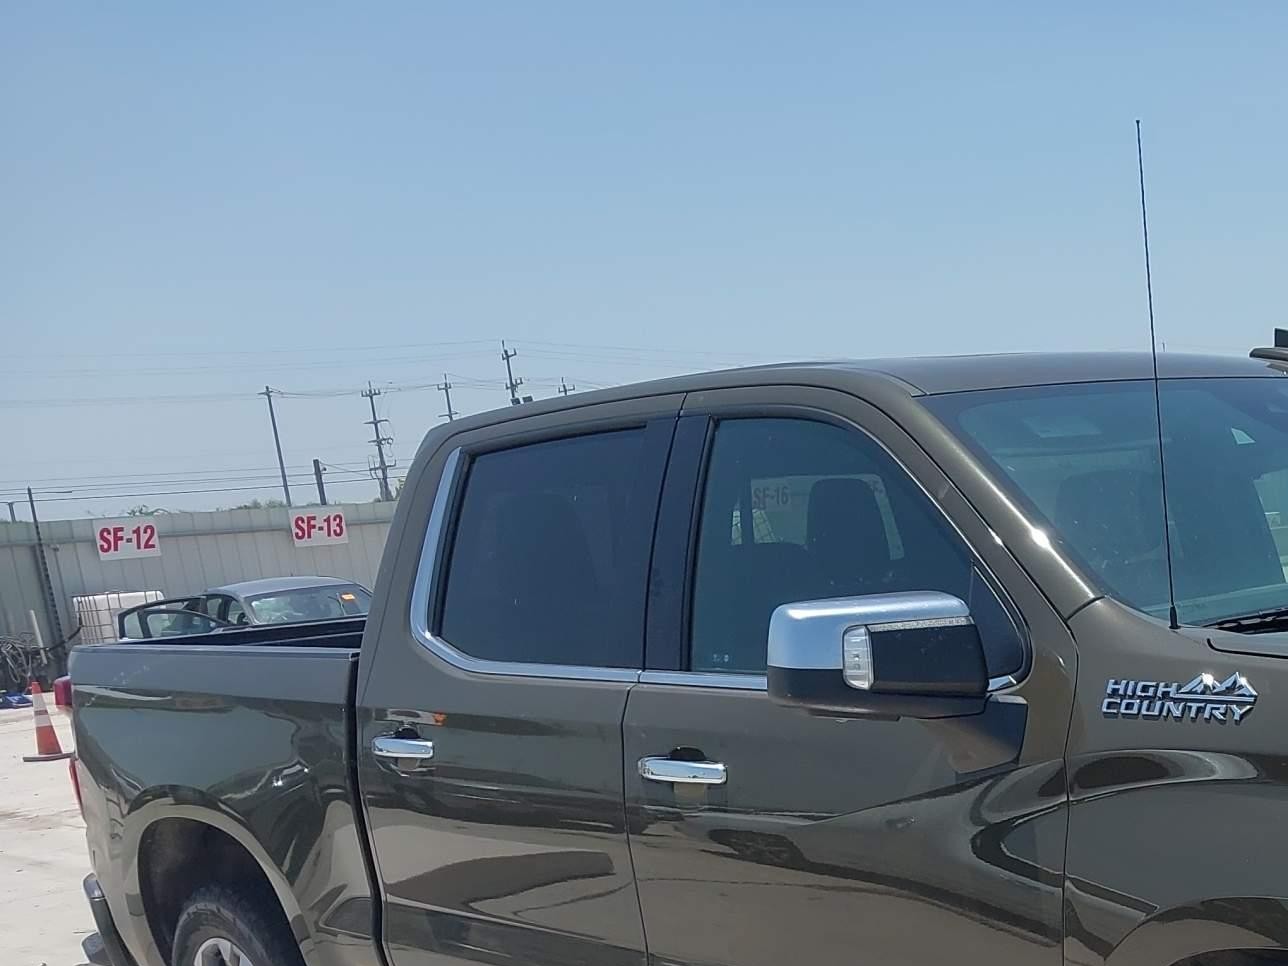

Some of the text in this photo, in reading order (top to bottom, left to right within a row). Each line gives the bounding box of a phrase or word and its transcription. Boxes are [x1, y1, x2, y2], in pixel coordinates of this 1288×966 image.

[99, 525, 156, 553] SF-12
[294, 514, 344, 540] SF-13
[1106, 679, 1180, 698] HIGH
[1102, 698, 1255, 722] COUNTRY
